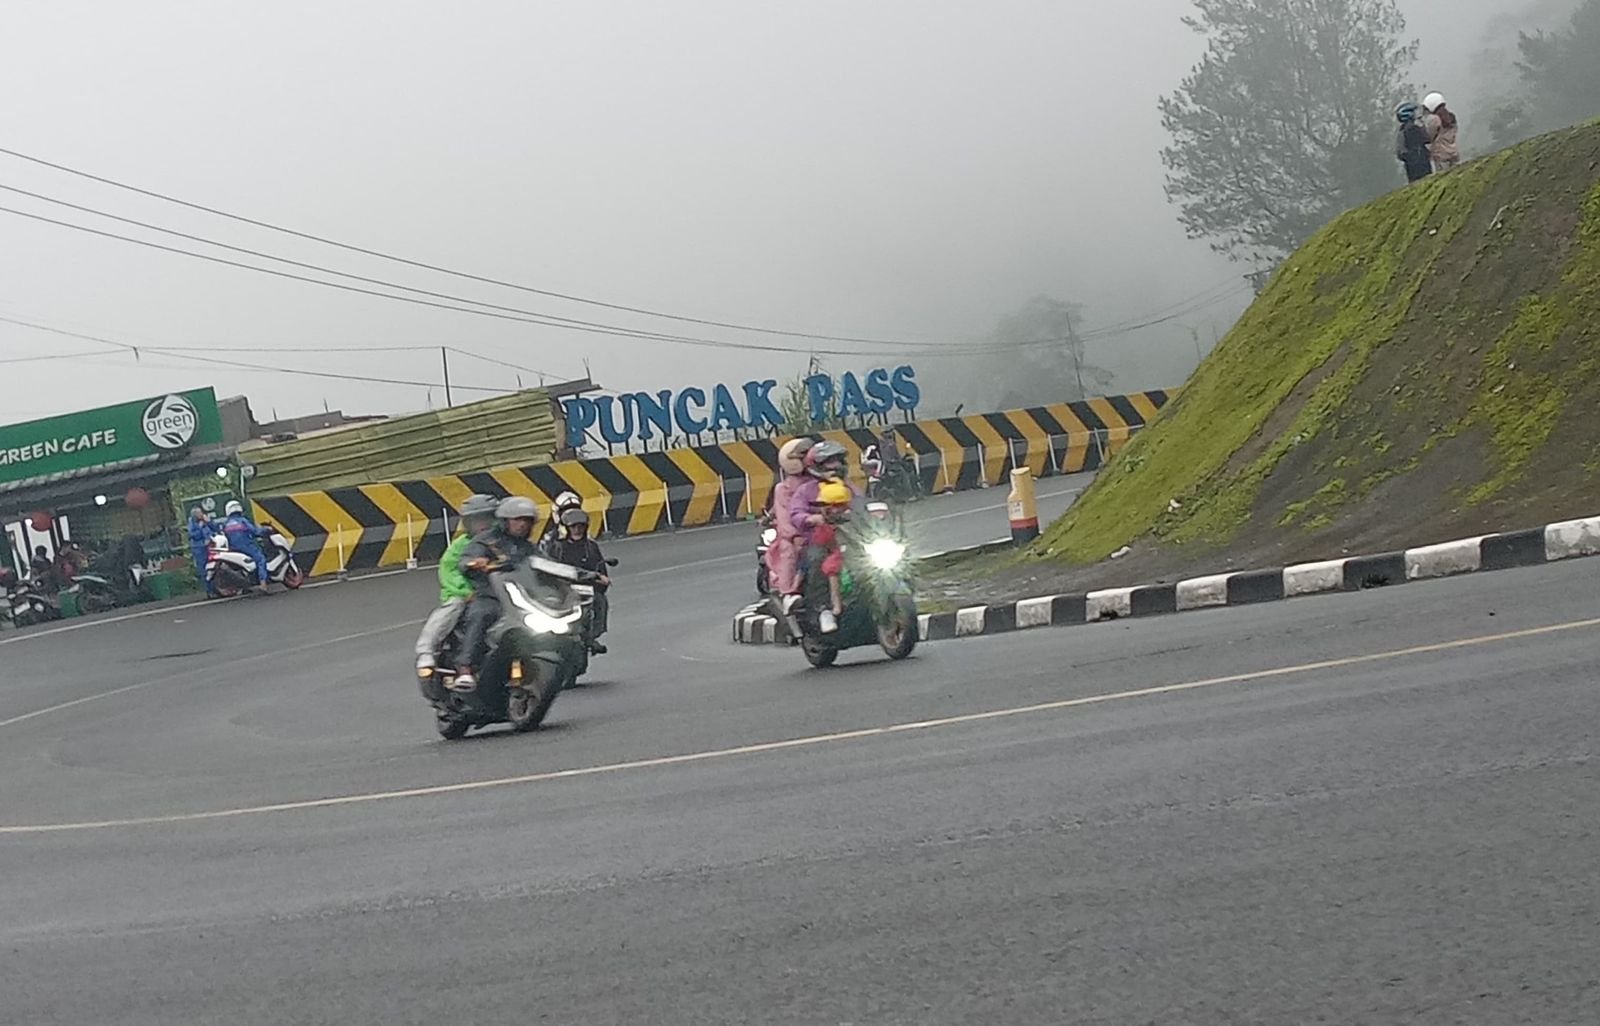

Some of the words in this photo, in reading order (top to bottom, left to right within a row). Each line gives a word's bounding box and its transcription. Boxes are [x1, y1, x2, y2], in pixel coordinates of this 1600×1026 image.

[146, 413, 193, 436] green
[562, 379, 785, 449] PUNCAK
[805, 365, 920, 422] PASS
[0, 438, 59, 465] GREEN
[61, 428, 117, 453] CAFE
